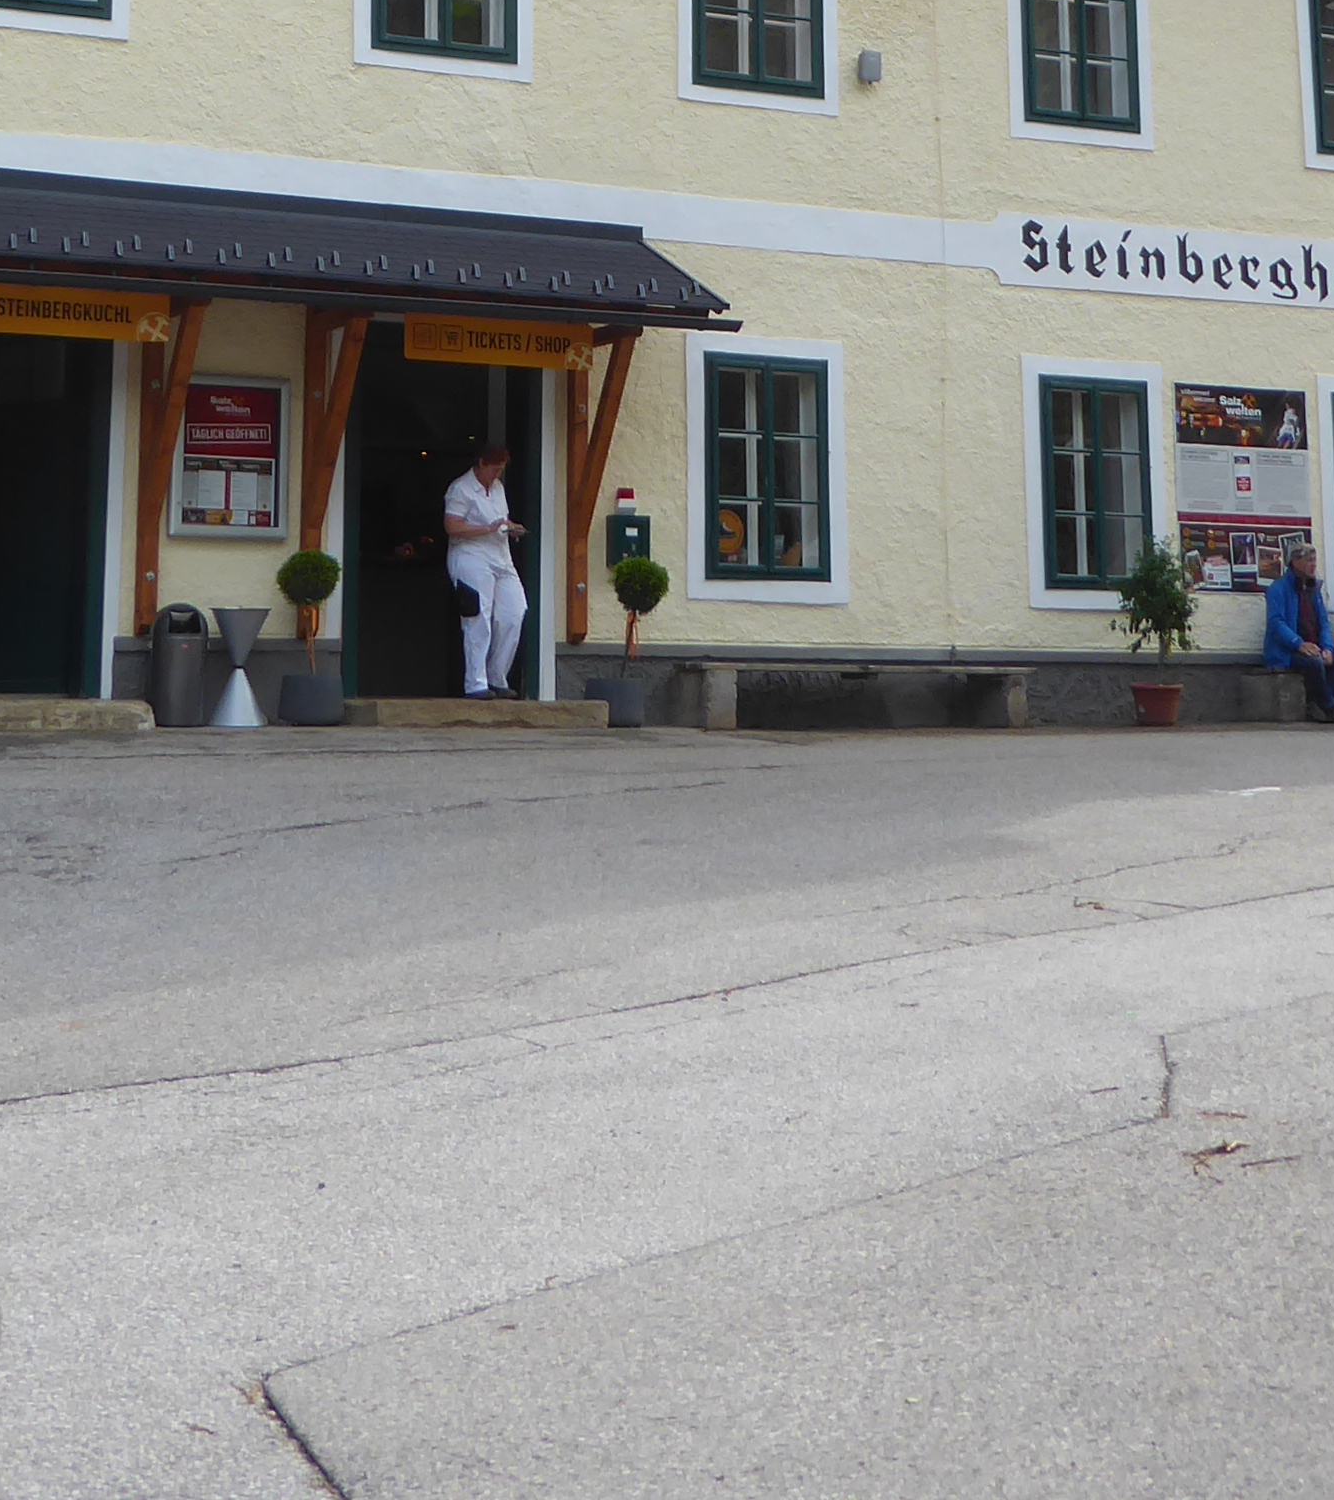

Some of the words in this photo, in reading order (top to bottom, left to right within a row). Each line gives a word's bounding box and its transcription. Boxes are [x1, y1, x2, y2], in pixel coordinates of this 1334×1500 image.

[467, 330, 522, 351] TICKETS
[524, 332, 532, 353] /
[535, 335, 571, 354] SHOP
[1219, 395, 1242, 405] Salz
[1225, 404, 1262, 416] welten
[191, 427, 224, 439] TÄGLICH
